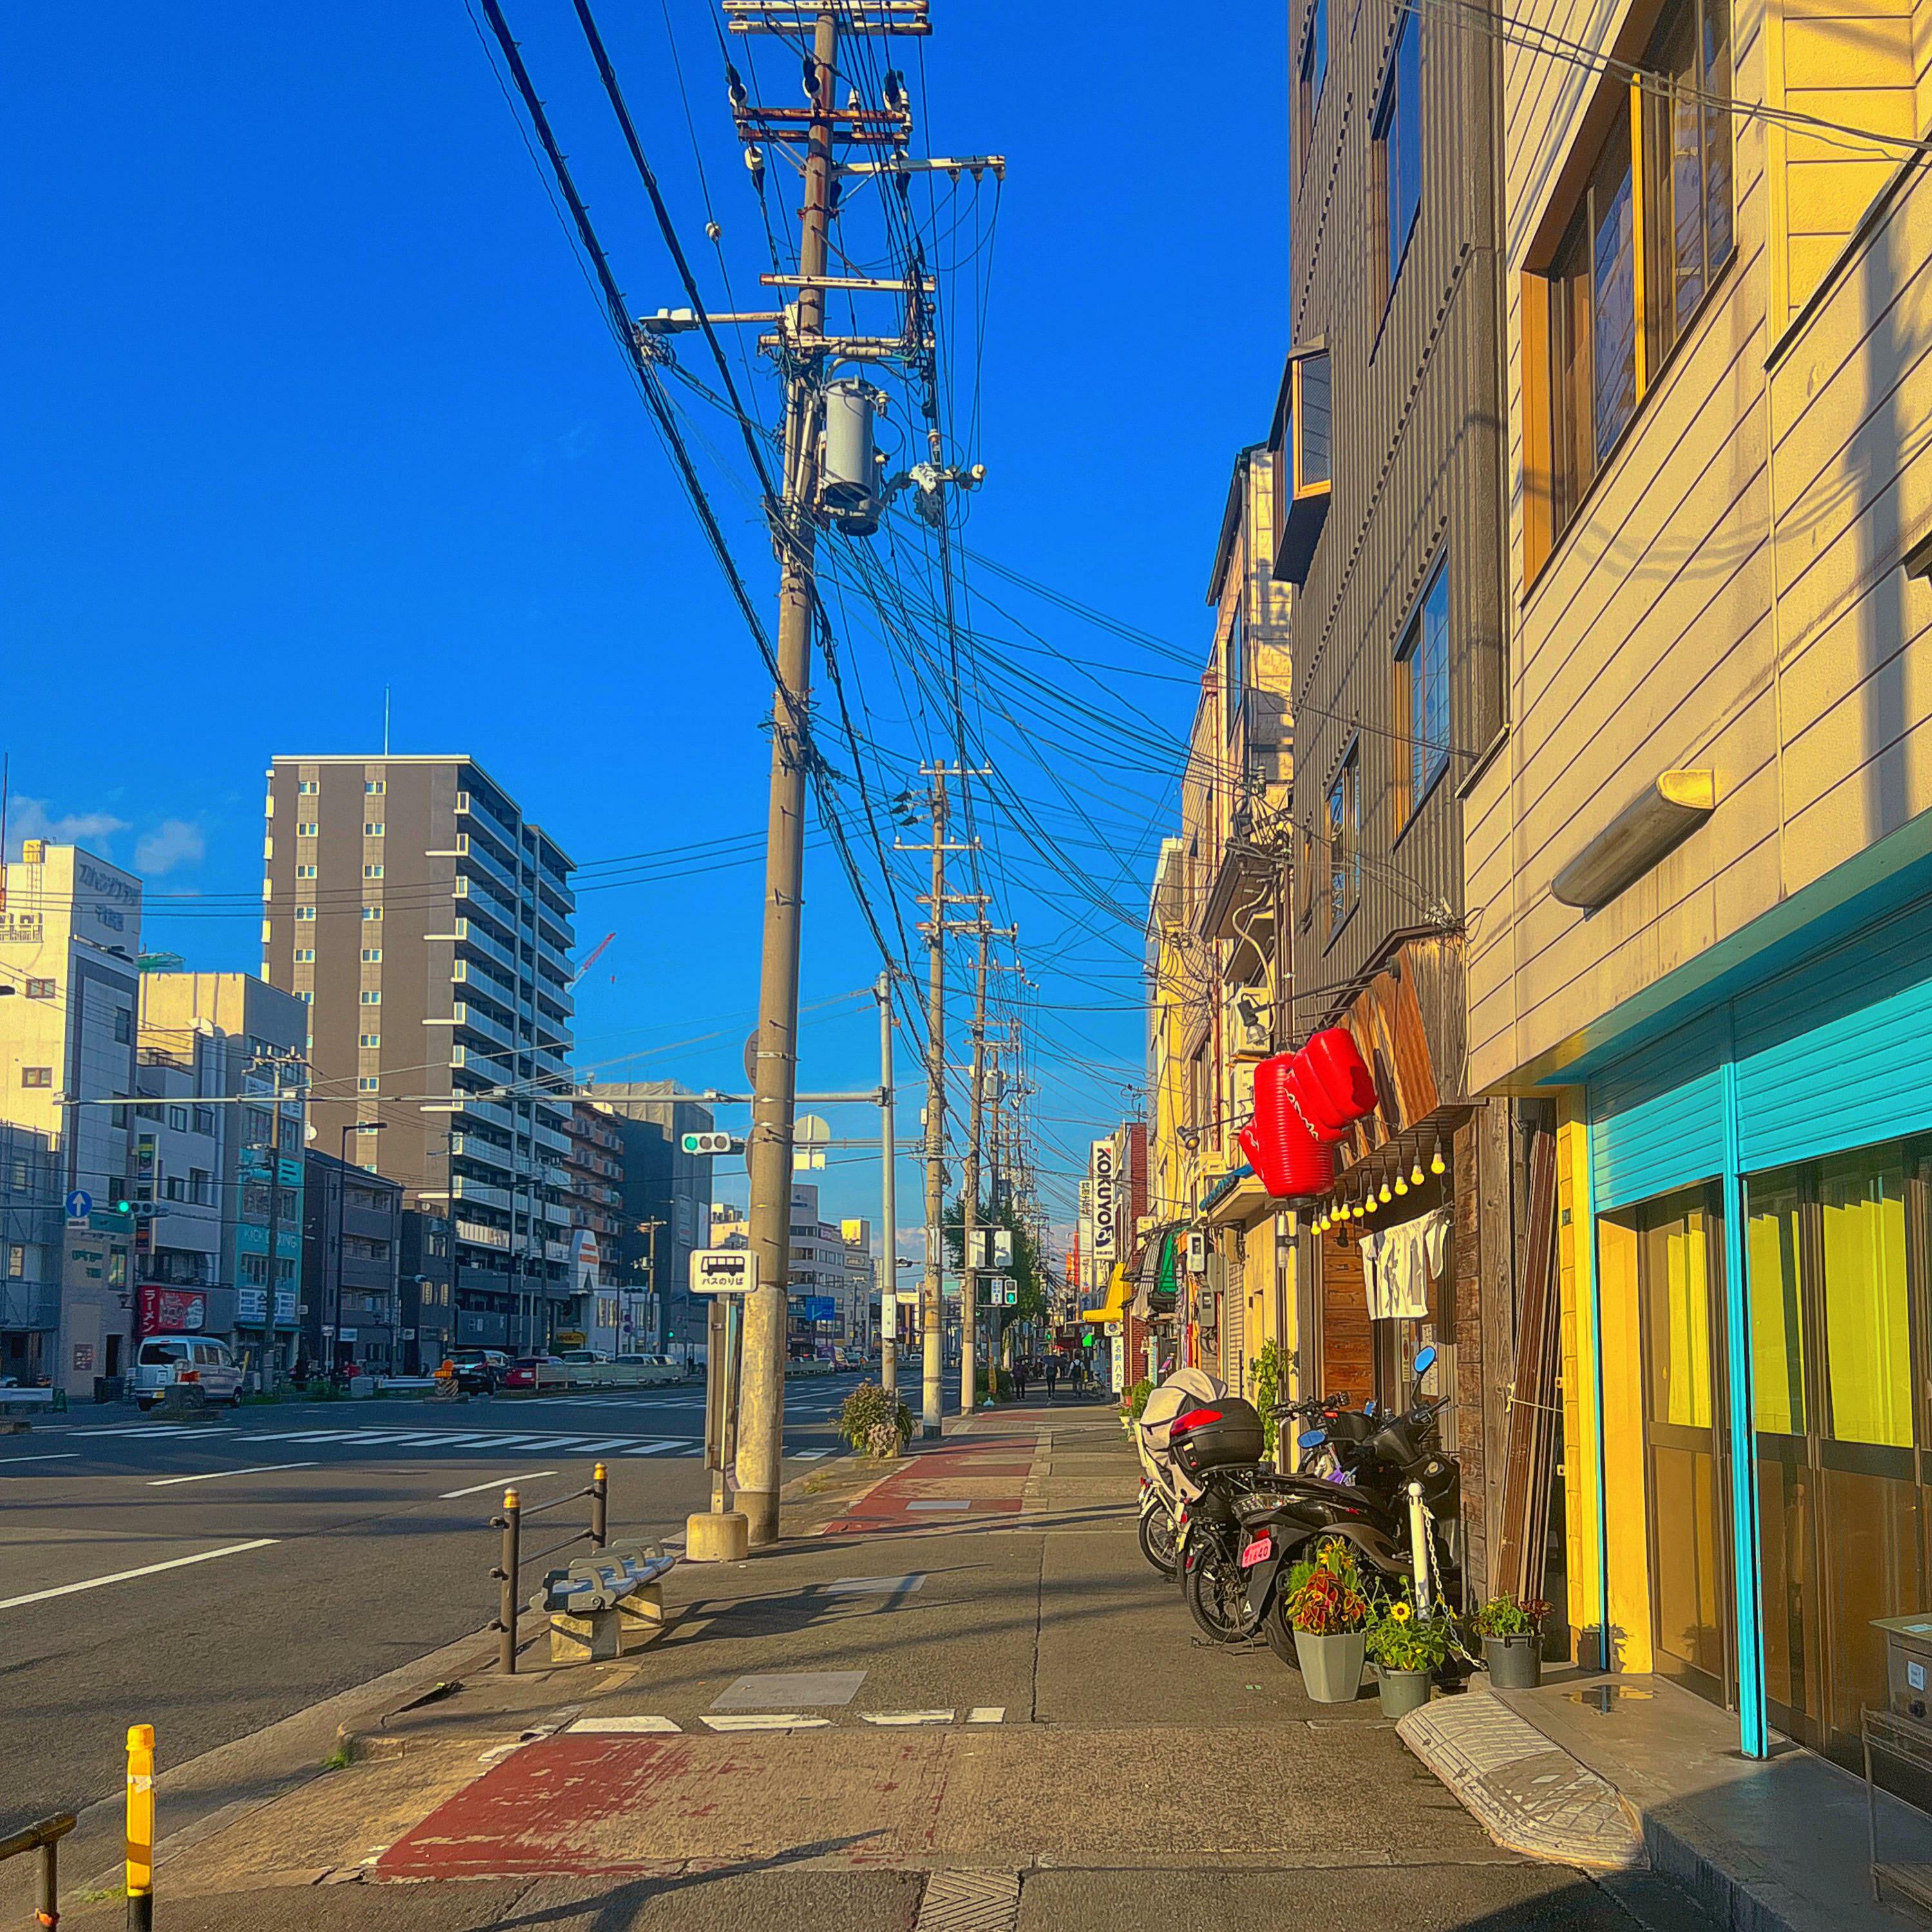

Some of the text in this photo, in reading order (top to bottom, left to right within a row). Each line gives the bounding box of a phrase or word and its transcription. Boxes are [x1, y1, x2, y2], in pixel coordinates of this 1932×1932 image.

[1097, 1148, 1112, 1225] KOKUYO
[702, 1277, 744, 1286] バスのりば
[143, 1289, 155, 1333] ラーメン
